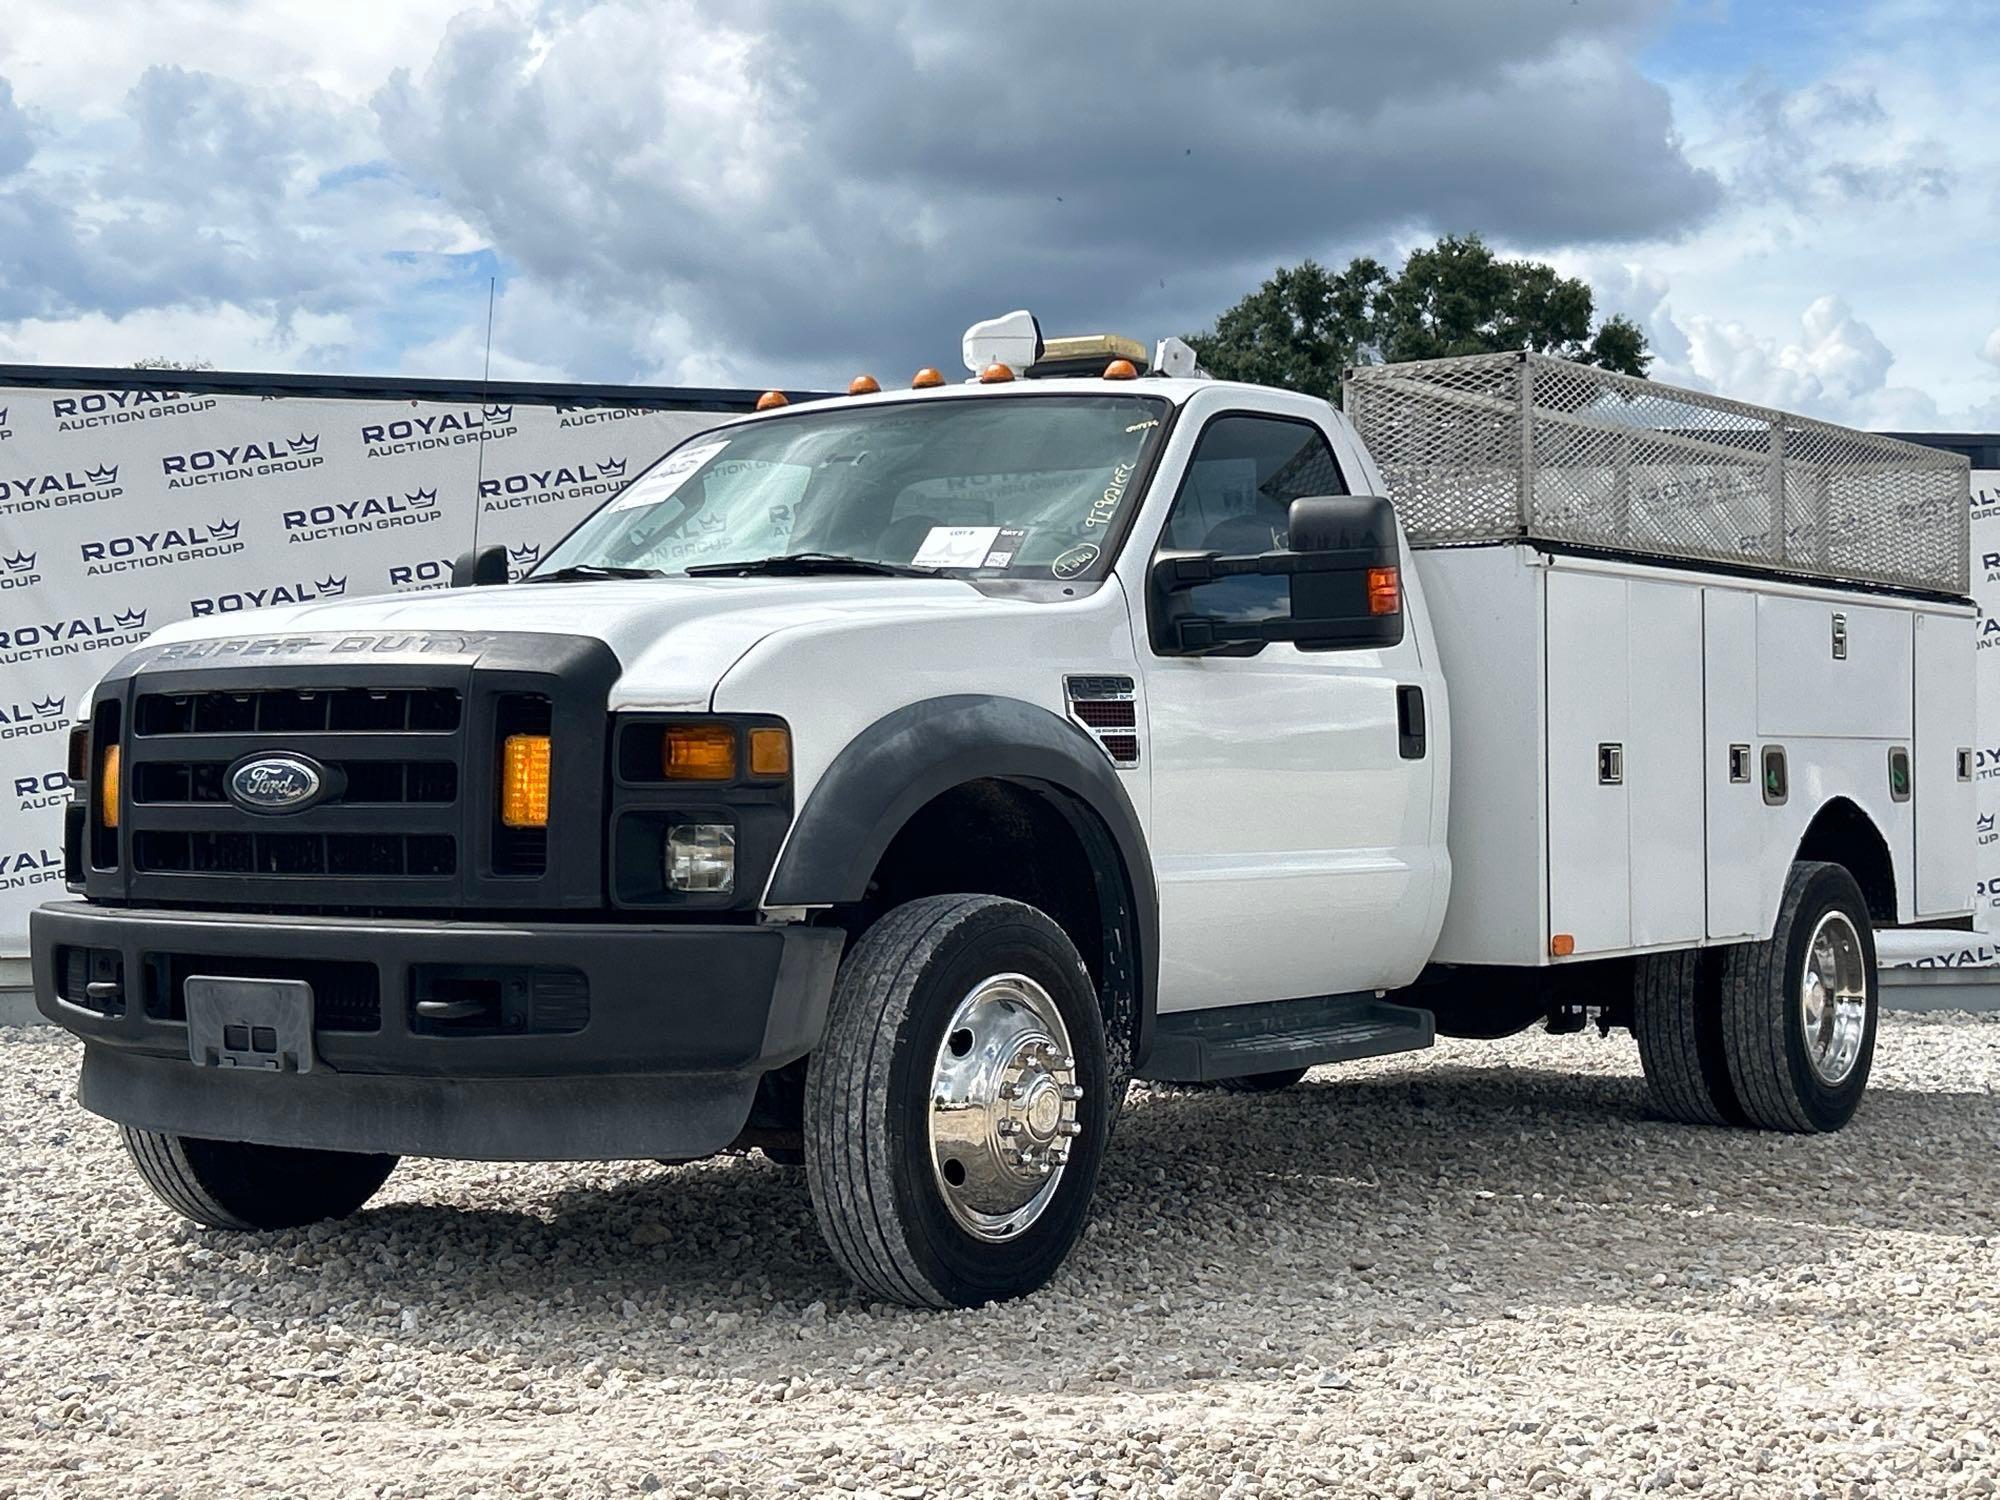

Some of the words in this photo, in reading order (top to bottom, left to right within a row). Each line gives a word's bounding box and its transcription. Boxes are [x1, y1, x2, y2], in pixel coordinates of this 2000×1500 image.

[53, 390, 180, 418] ROYAL
[58, 411, 145, 432] AUCTION
[149, 400, 216, 418] GROUP
[559, 408, 639, 429] AUCTION
[361, 411, 483, 445] ROYAL
[367, 437, 449, 458] AUCTION
[453, 426, 517, 446] GROUP
[162, 440, 287, 475] ROYAL
[168, 467, 253, 490] AUCTION
[257, 456, 323, 476] GROUP
[480, 465, 597, 499] ROYAL
[0, 498, 50, 515] TION
[54, 487, 123, 507] GROUP
[283, 496, 406, 530] ROYAL
[485, 491, 565, 513] AUCTION
[289, 522, 372, 544] AUCTION
[376, 511, 441, 530] GROUP
[81, 527, 207, 562] ROYAL
[87, 553, 172, 576] AUCTION
[177, 542, 244, 562] GROUP
[191, 583, 315, 617] ROYAL
[82, 632, 150, 651] GROUP
[157, 637, 311, 662] SUPER
[329, 636, 485, 653] DUTY
[2, 719, 70, 739] GROUP
[247, 767, 293, 794] Ford
[1894, 947, 1992, 968] OYAL
